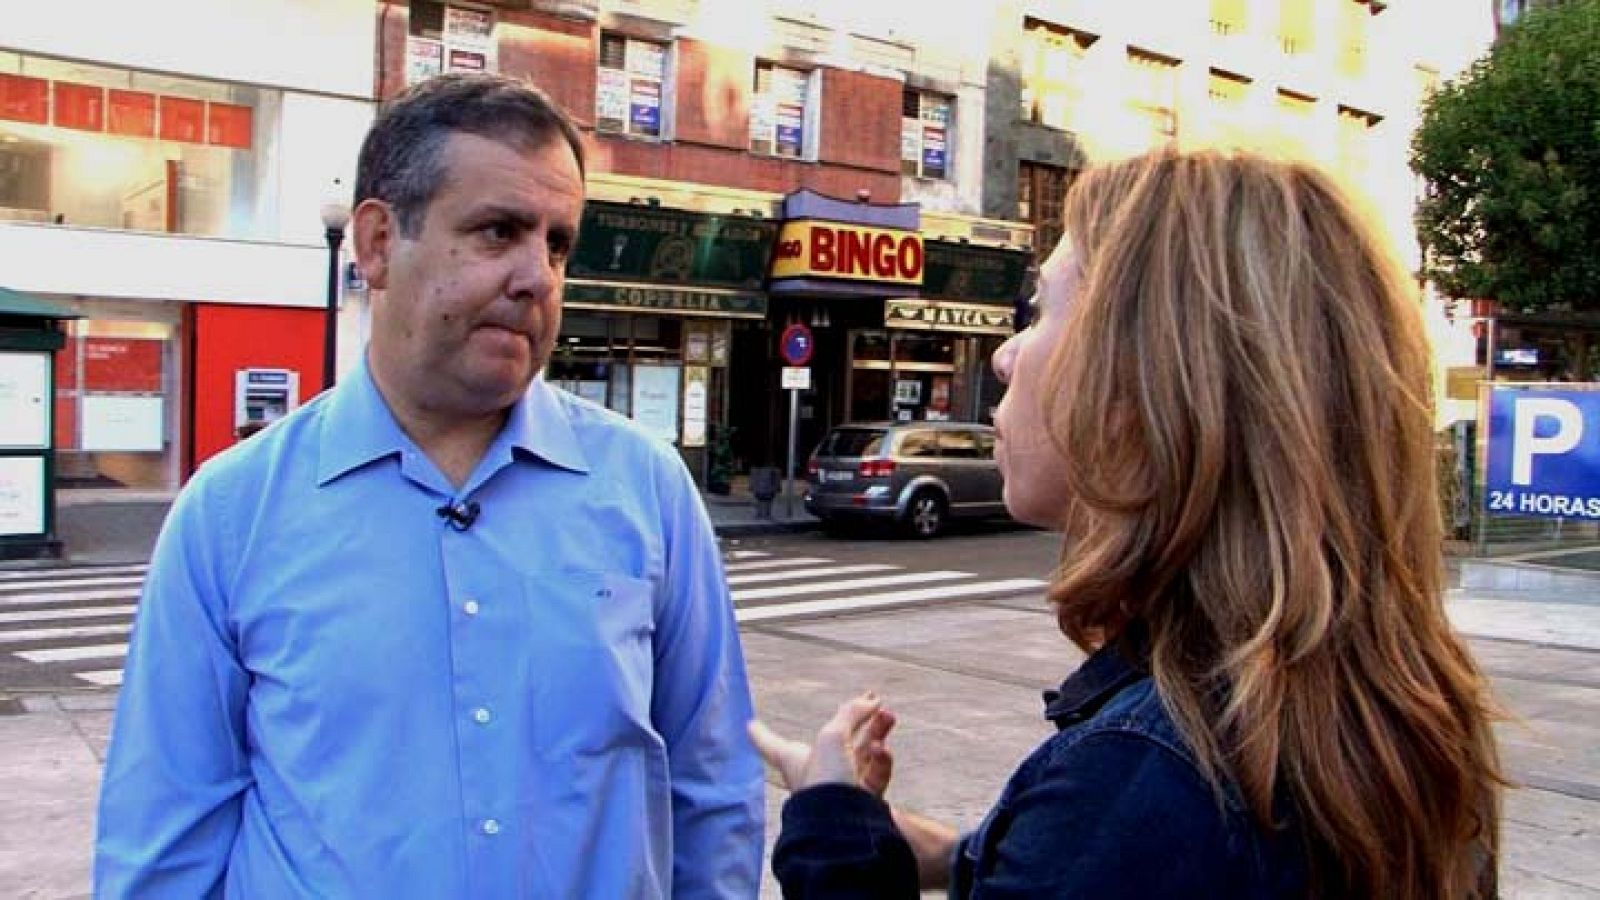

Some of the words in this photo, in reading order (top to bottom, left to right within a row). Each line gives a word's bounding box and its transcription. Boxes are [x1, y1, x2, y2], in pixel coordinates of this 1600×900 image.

[810, 226, 923, 279] BINGO
[1512, 397, 1585, 486] P
[1490, 490, 1514, 510] 24
[1519, 492, 1600, 518] HORAS
